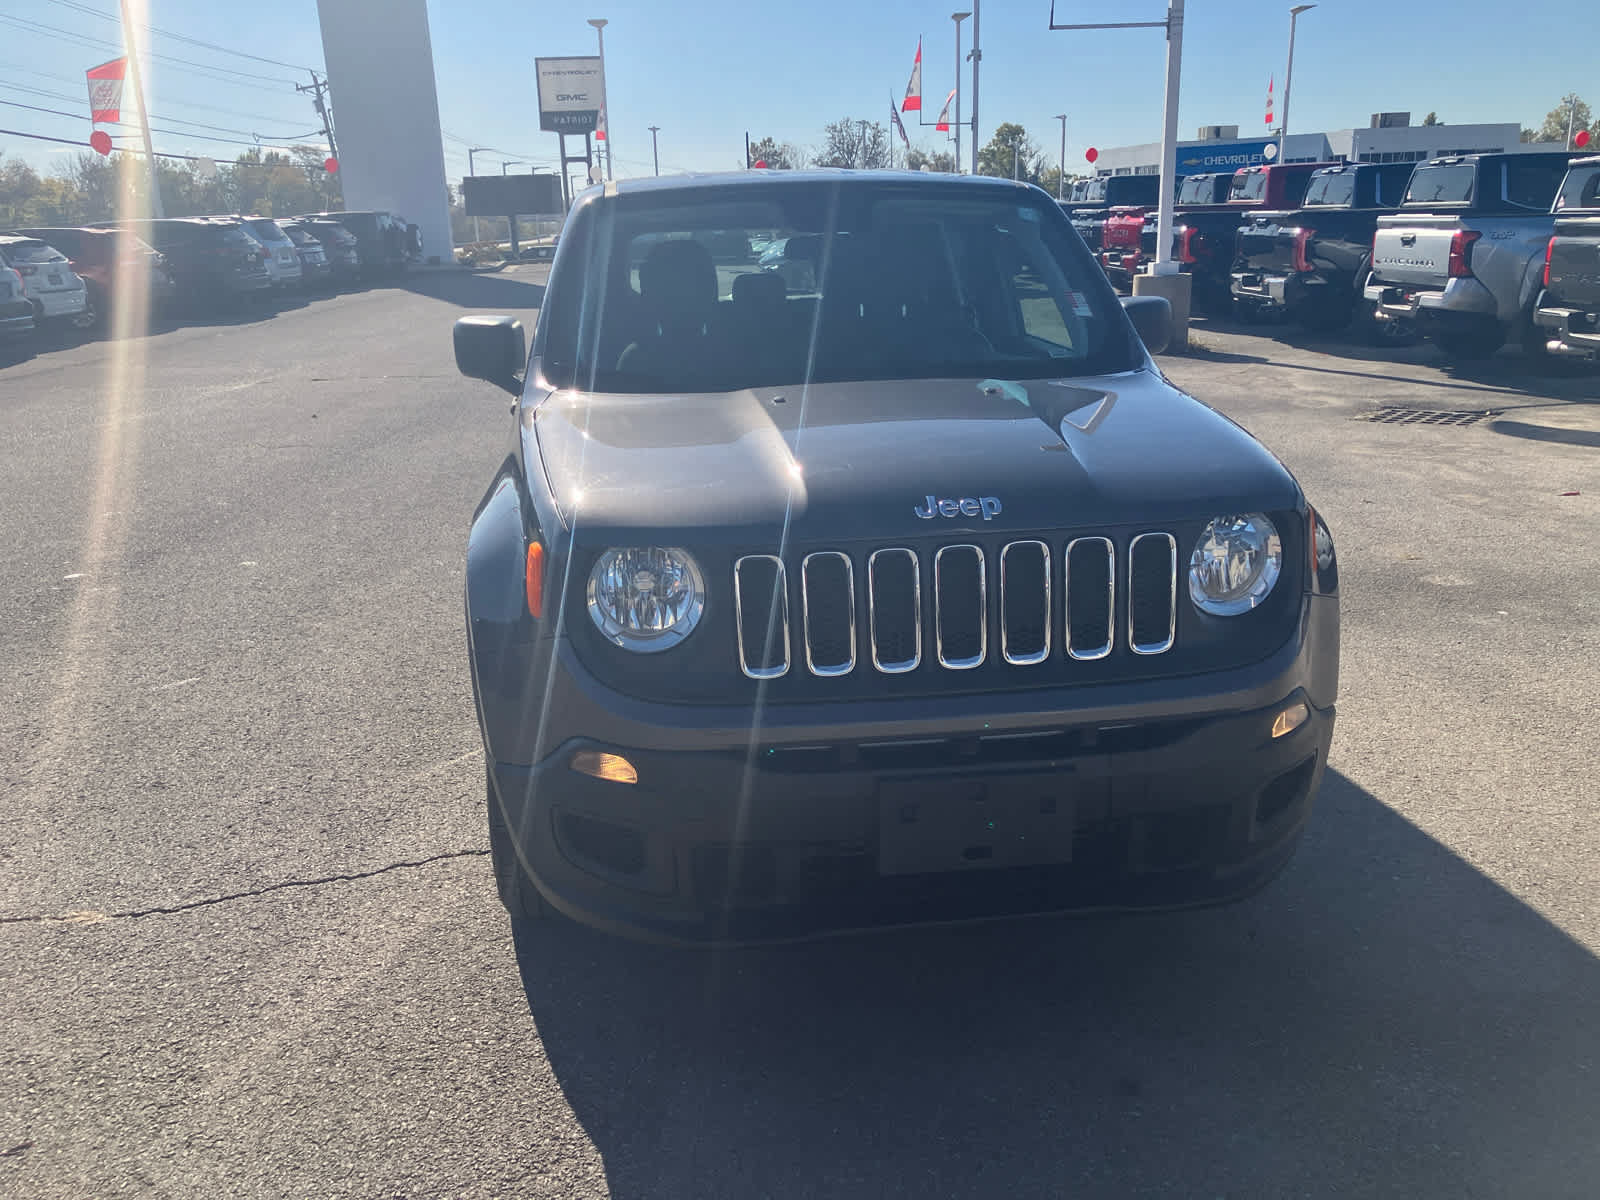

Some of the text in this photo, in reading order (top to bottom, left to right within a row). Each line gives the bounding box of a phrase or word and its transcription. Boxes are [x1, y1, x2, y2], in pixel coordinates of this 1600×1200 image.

[556, 94, 589, 102] GMC
[553, 115, 592, 124] PATRIOT
[1204, 154, 1264, 166] CHEVROLET
[1382, 256, 1435, 267] TACOMA
[914, 495, 1002, 521] Jeep
